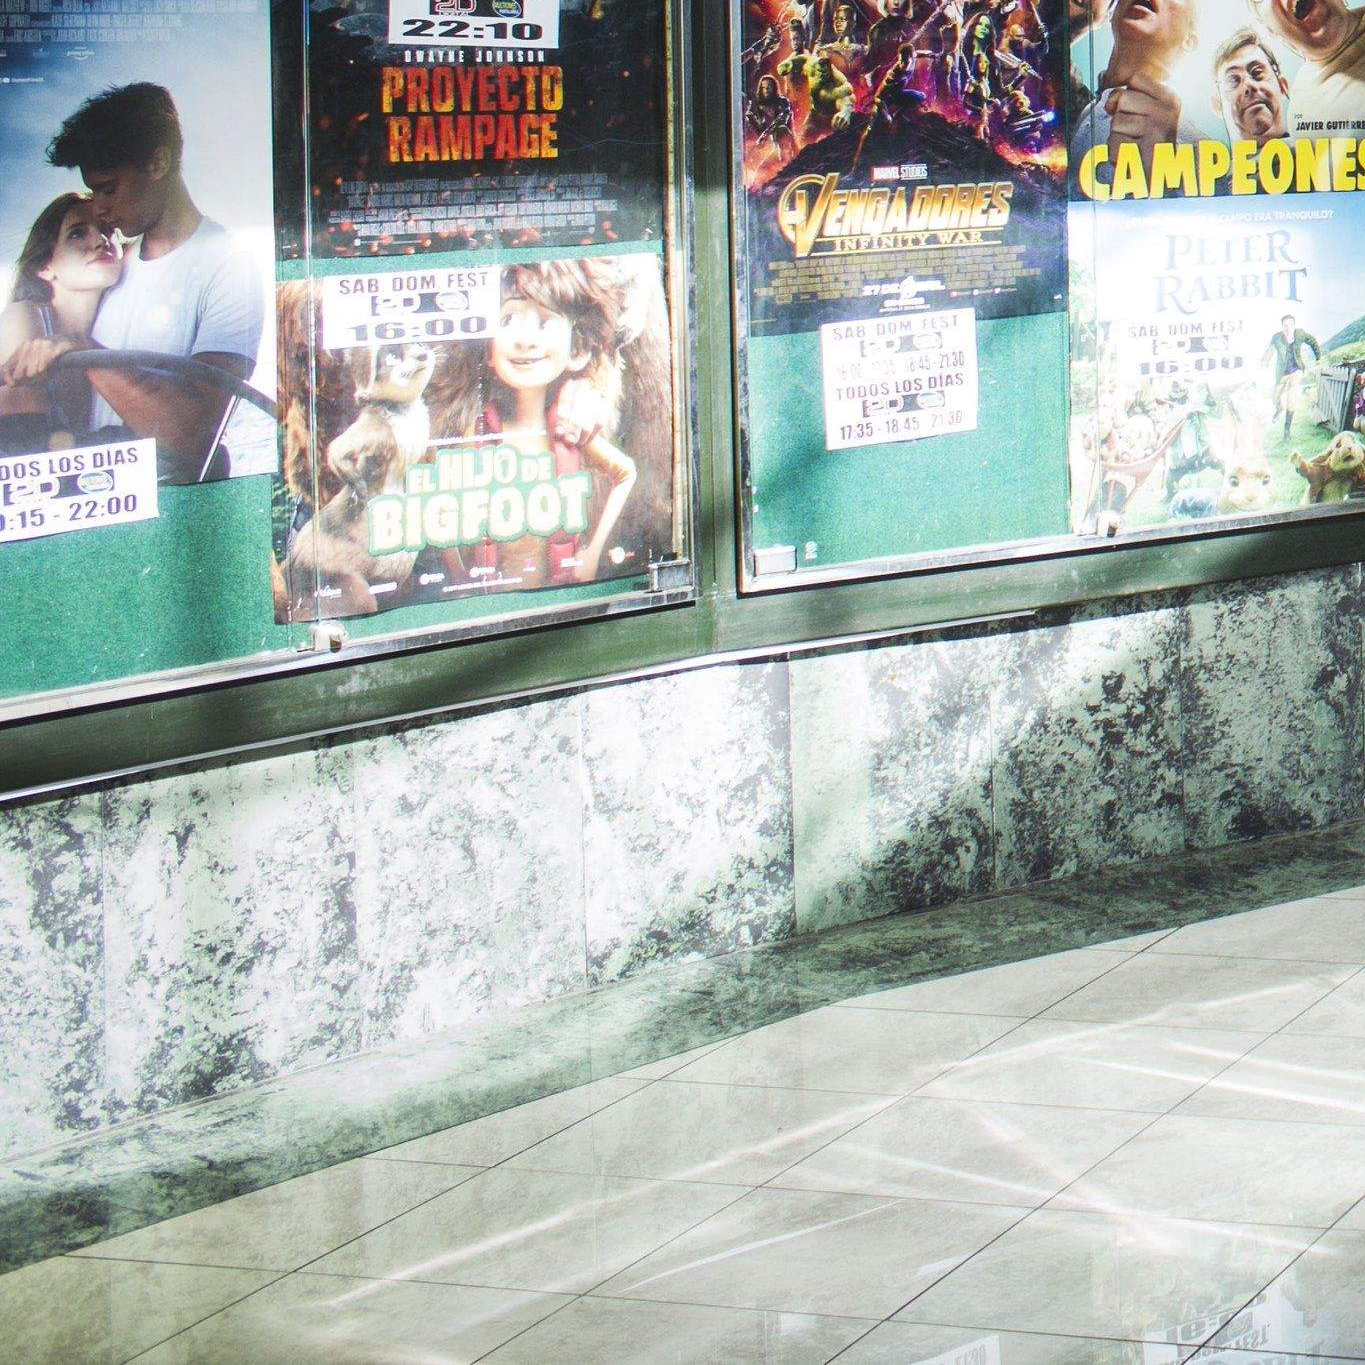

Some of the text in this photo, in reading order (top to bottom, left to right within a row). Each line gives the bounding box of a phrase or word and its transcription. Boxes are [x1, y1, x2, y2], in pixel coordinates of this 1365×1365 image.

[403, 19, 543, 40] 22:10
[404, 50, 545, 63] DWAYNE JOHNSON
[382, 66, 564, 113] PROYECTO
[389, 113, 558, 162] RAMPAGE
[1296, 120, 1324, 130] JAVIER
[778, 172, 1014, 258] VENGADORES
[832, 231, 984, 251] INFINITY WAR
[1166, 229, 1300, 270] PETER
[339, 272, 489, 295] SAB DOM FEST
[1154, 268, 1308, 316] RABBIT
[348, 316, 487, 342] 16:00
[836, 373, 964, 401] TODOS LOS DÍAS
[408, 448, 551, 493] EL HIJO DE
[371, 475, 590, 553] BIGFOOT
